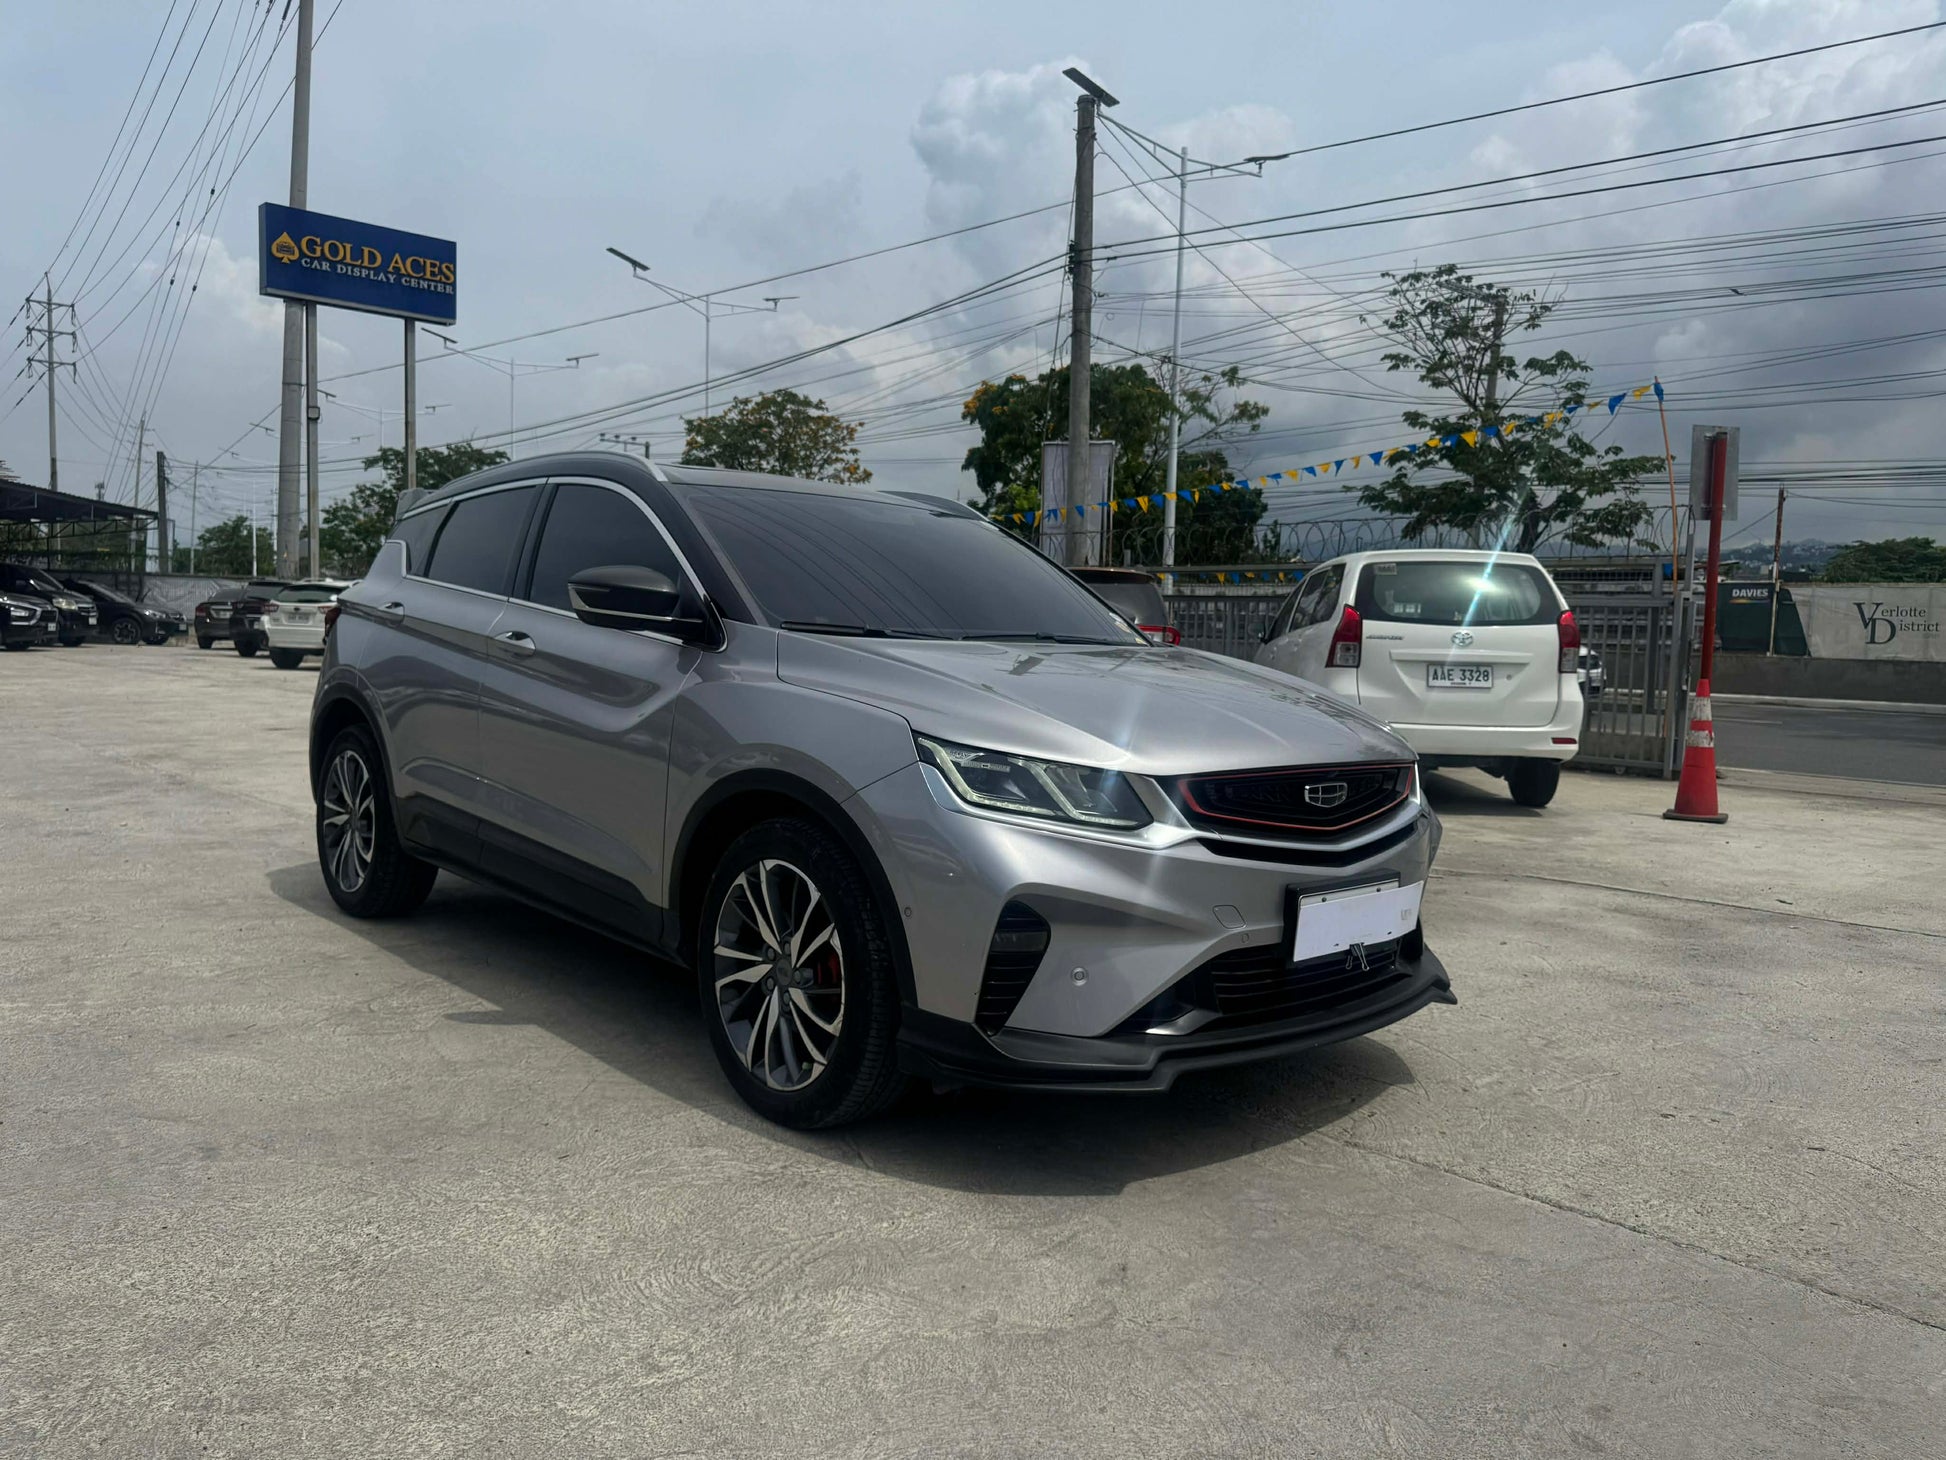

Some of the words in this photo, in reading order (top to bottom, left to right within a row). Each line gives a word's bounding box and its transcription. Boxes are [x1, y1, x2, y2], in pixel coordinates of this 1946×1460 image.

[301, 235, 382, 268] GOLD
[388, 252, 455, 284] ACES
[301, 257, 331, 272] CAR
[336, 263, 397, 284] DISPLAY
[401, 276, 455, 295] CENTER
[1731, 588, 1769, 598] DAVIES
[1853, 602, 1926, 630] Verlotte
[1865, 618, 1940, 645] District
[1432, 668, 1455, 681] AAE
[1459, 669, 1490, 682] 3328
